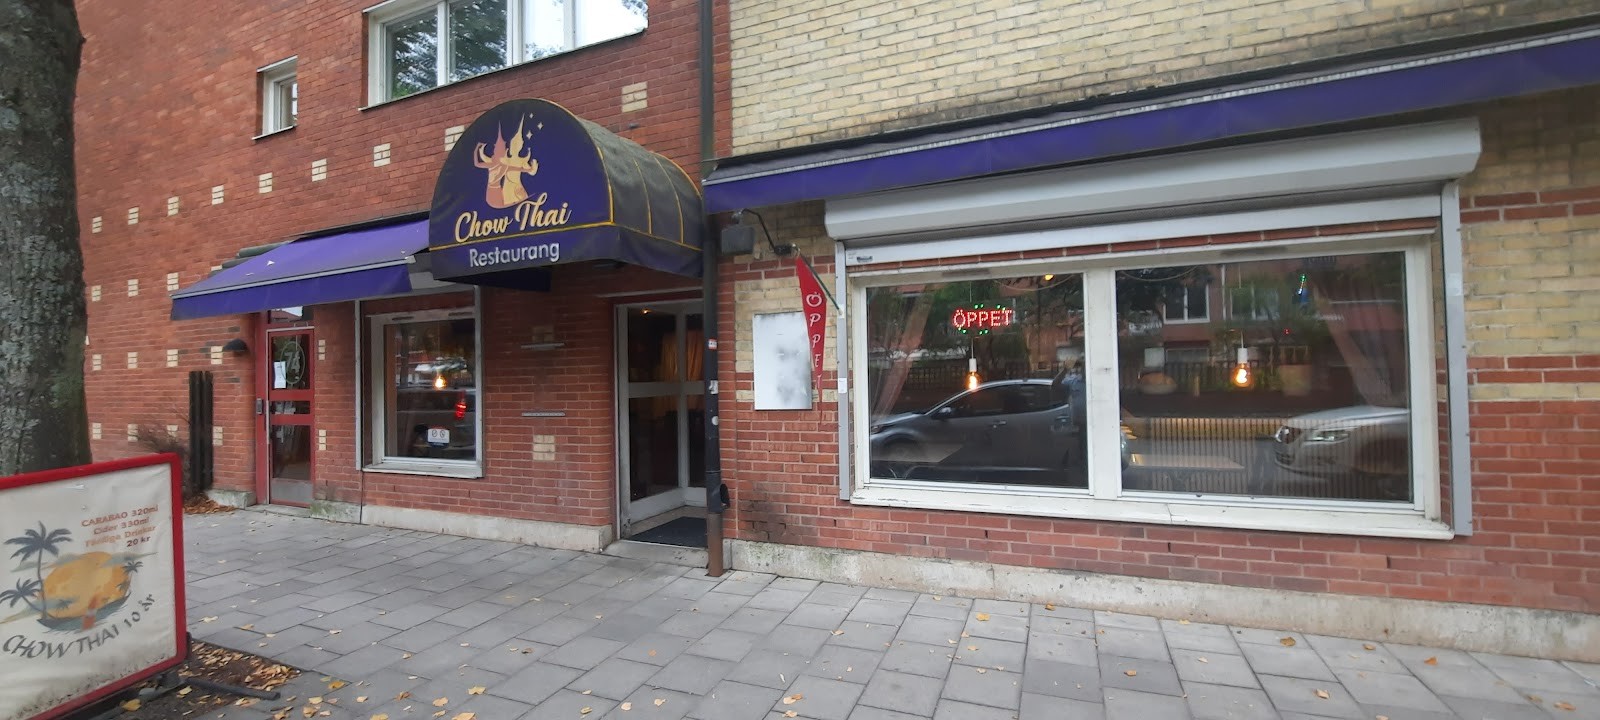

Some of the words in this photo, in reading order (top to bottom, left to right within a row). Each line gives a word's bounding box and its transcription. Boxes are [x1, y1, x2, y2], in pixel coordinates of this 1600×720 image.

[455, 211, 513, 243] Chow
[515, 192, 572, 230] Thai
[469, 242, 560, 267] Restaurang
[953, 309, 1013, 327] ÖPPET
[806, 292, 823, 388] ÖPPET
[131, 504, 159, 516] 320ml
[94, 524, 118, 535] Cider
[126, 538, 139, 547] 20
[3, 634, 75, 659] CHOW
[74, 624, 120, 654] THAI
[123, 611, 141, 628] 10
